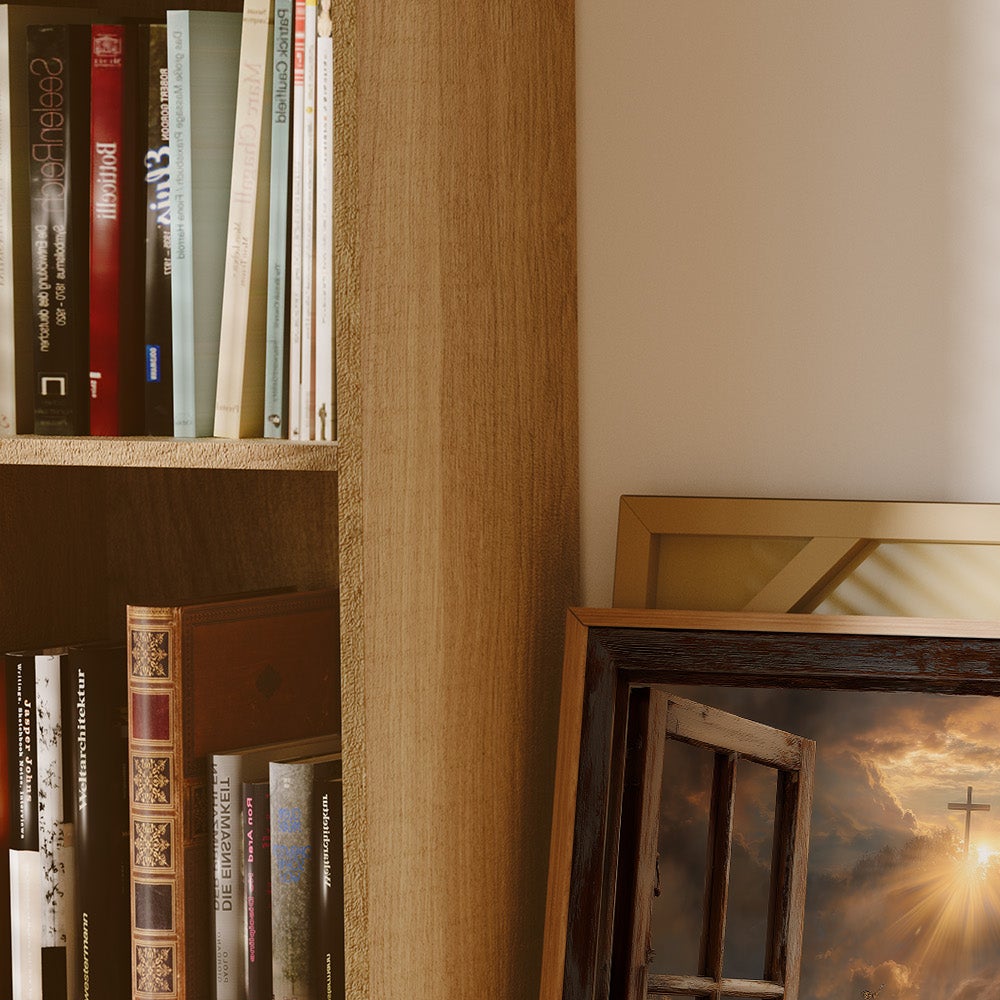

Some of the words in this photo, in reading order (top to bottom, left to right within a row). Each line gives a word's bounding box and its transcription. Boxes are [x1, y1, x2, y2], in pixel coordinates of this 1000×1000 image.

[23, 699, 32, 752] Jasper
[77, 668, 88, 811] Weltarchitektur
[24, 756, 33, 803] Johns
